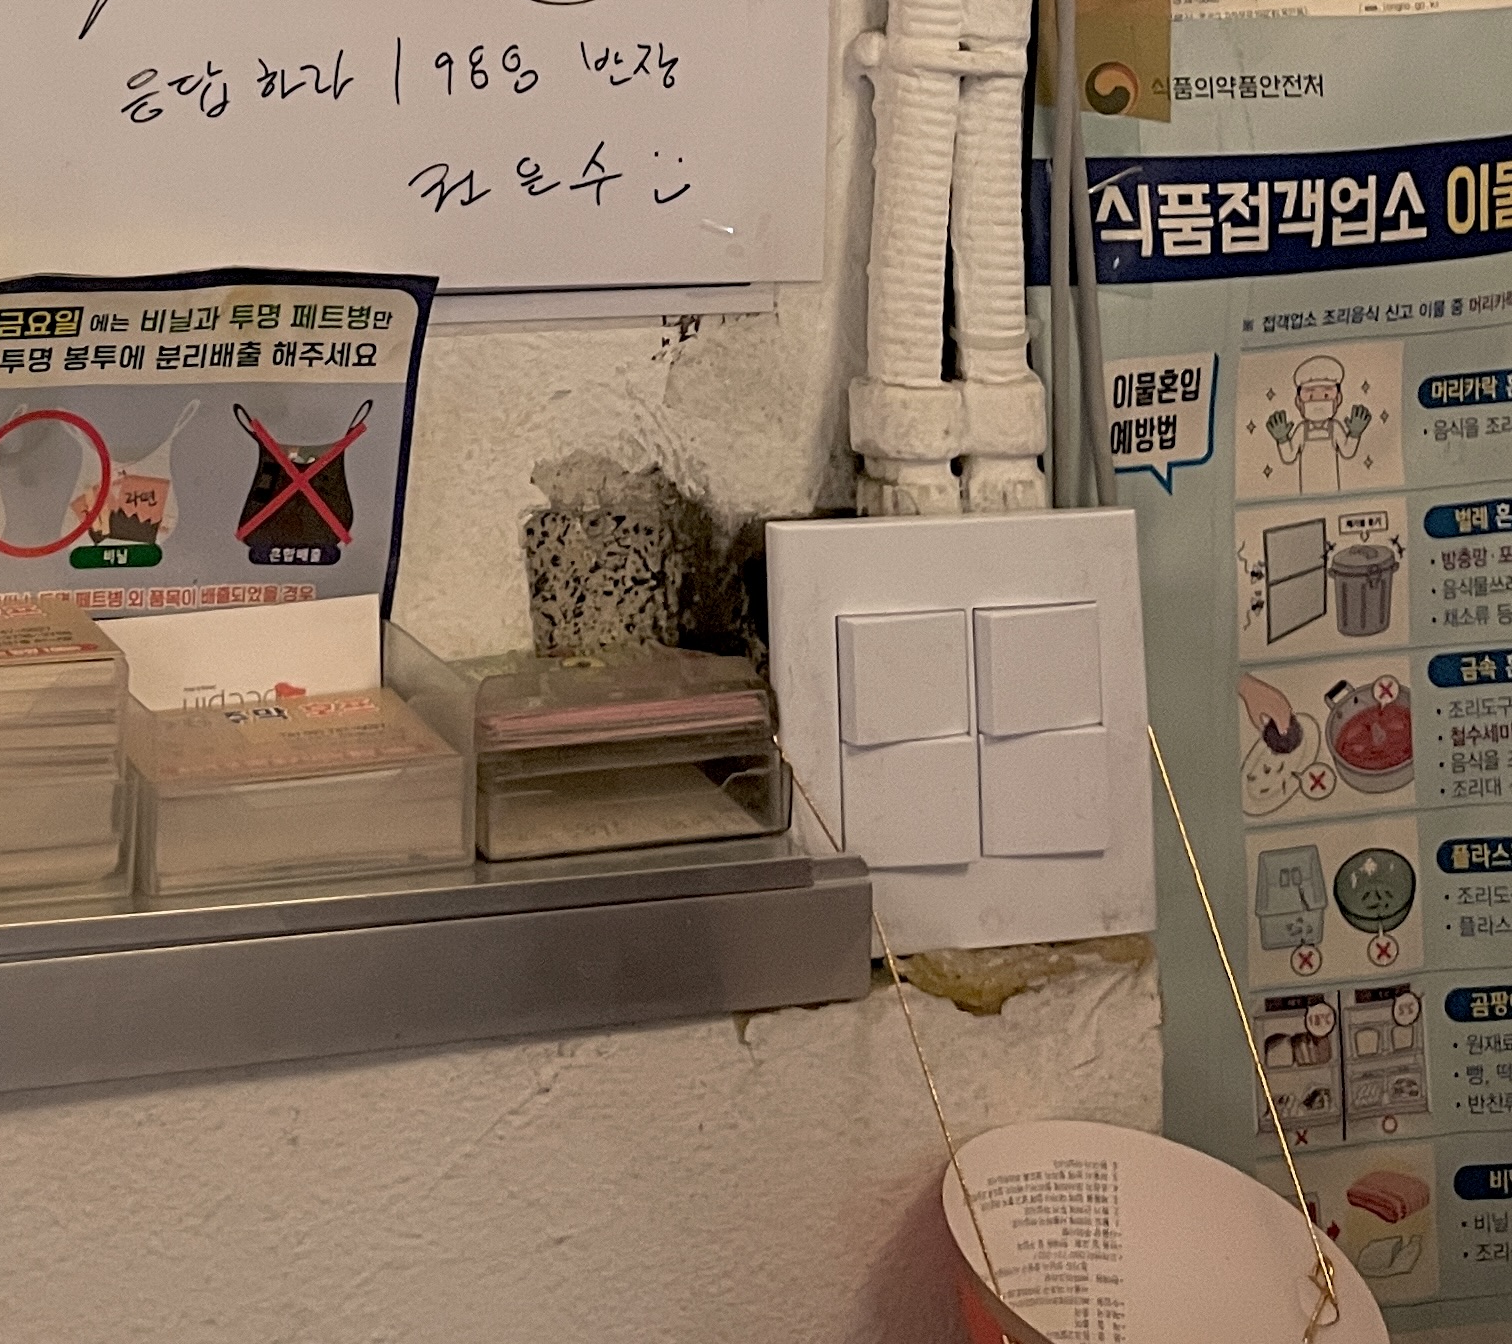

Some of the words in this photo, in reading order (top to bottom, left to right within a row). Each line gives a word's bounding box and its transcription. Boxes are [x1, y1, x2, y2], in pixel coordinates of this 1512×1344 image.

[120, 61, 231, 124] 응답
[256, 48, 355, 101] 하라
[1151, 72, 1325, 103] 식품의약품안전처
[1095, 170, 1428, 259] 식품접객업소
[90, 313, 130, 334] 에는
[139, 306, 220, 334] 비닐과
[229, 304, 281, 331] 투명
[291, 305, 393, 331] 페트병만
[1385, 303, 1414, 322] 신고
[63, 342, 145, 371] 봉투에
[155, 341, 262, 371] 분리배출
[272, 340, 378, 370] 해주세요
[1112, 366, 1203, 409] 이물혼입
[1431, 375, 1500, 405] 머리카락
[1110, 413, 1179, 457] 예방법
[1454, 504, 1489, 534] 벌레
[149, 587, 196, 608] 품목이
[1459, 656, 1498, 682] 금속
